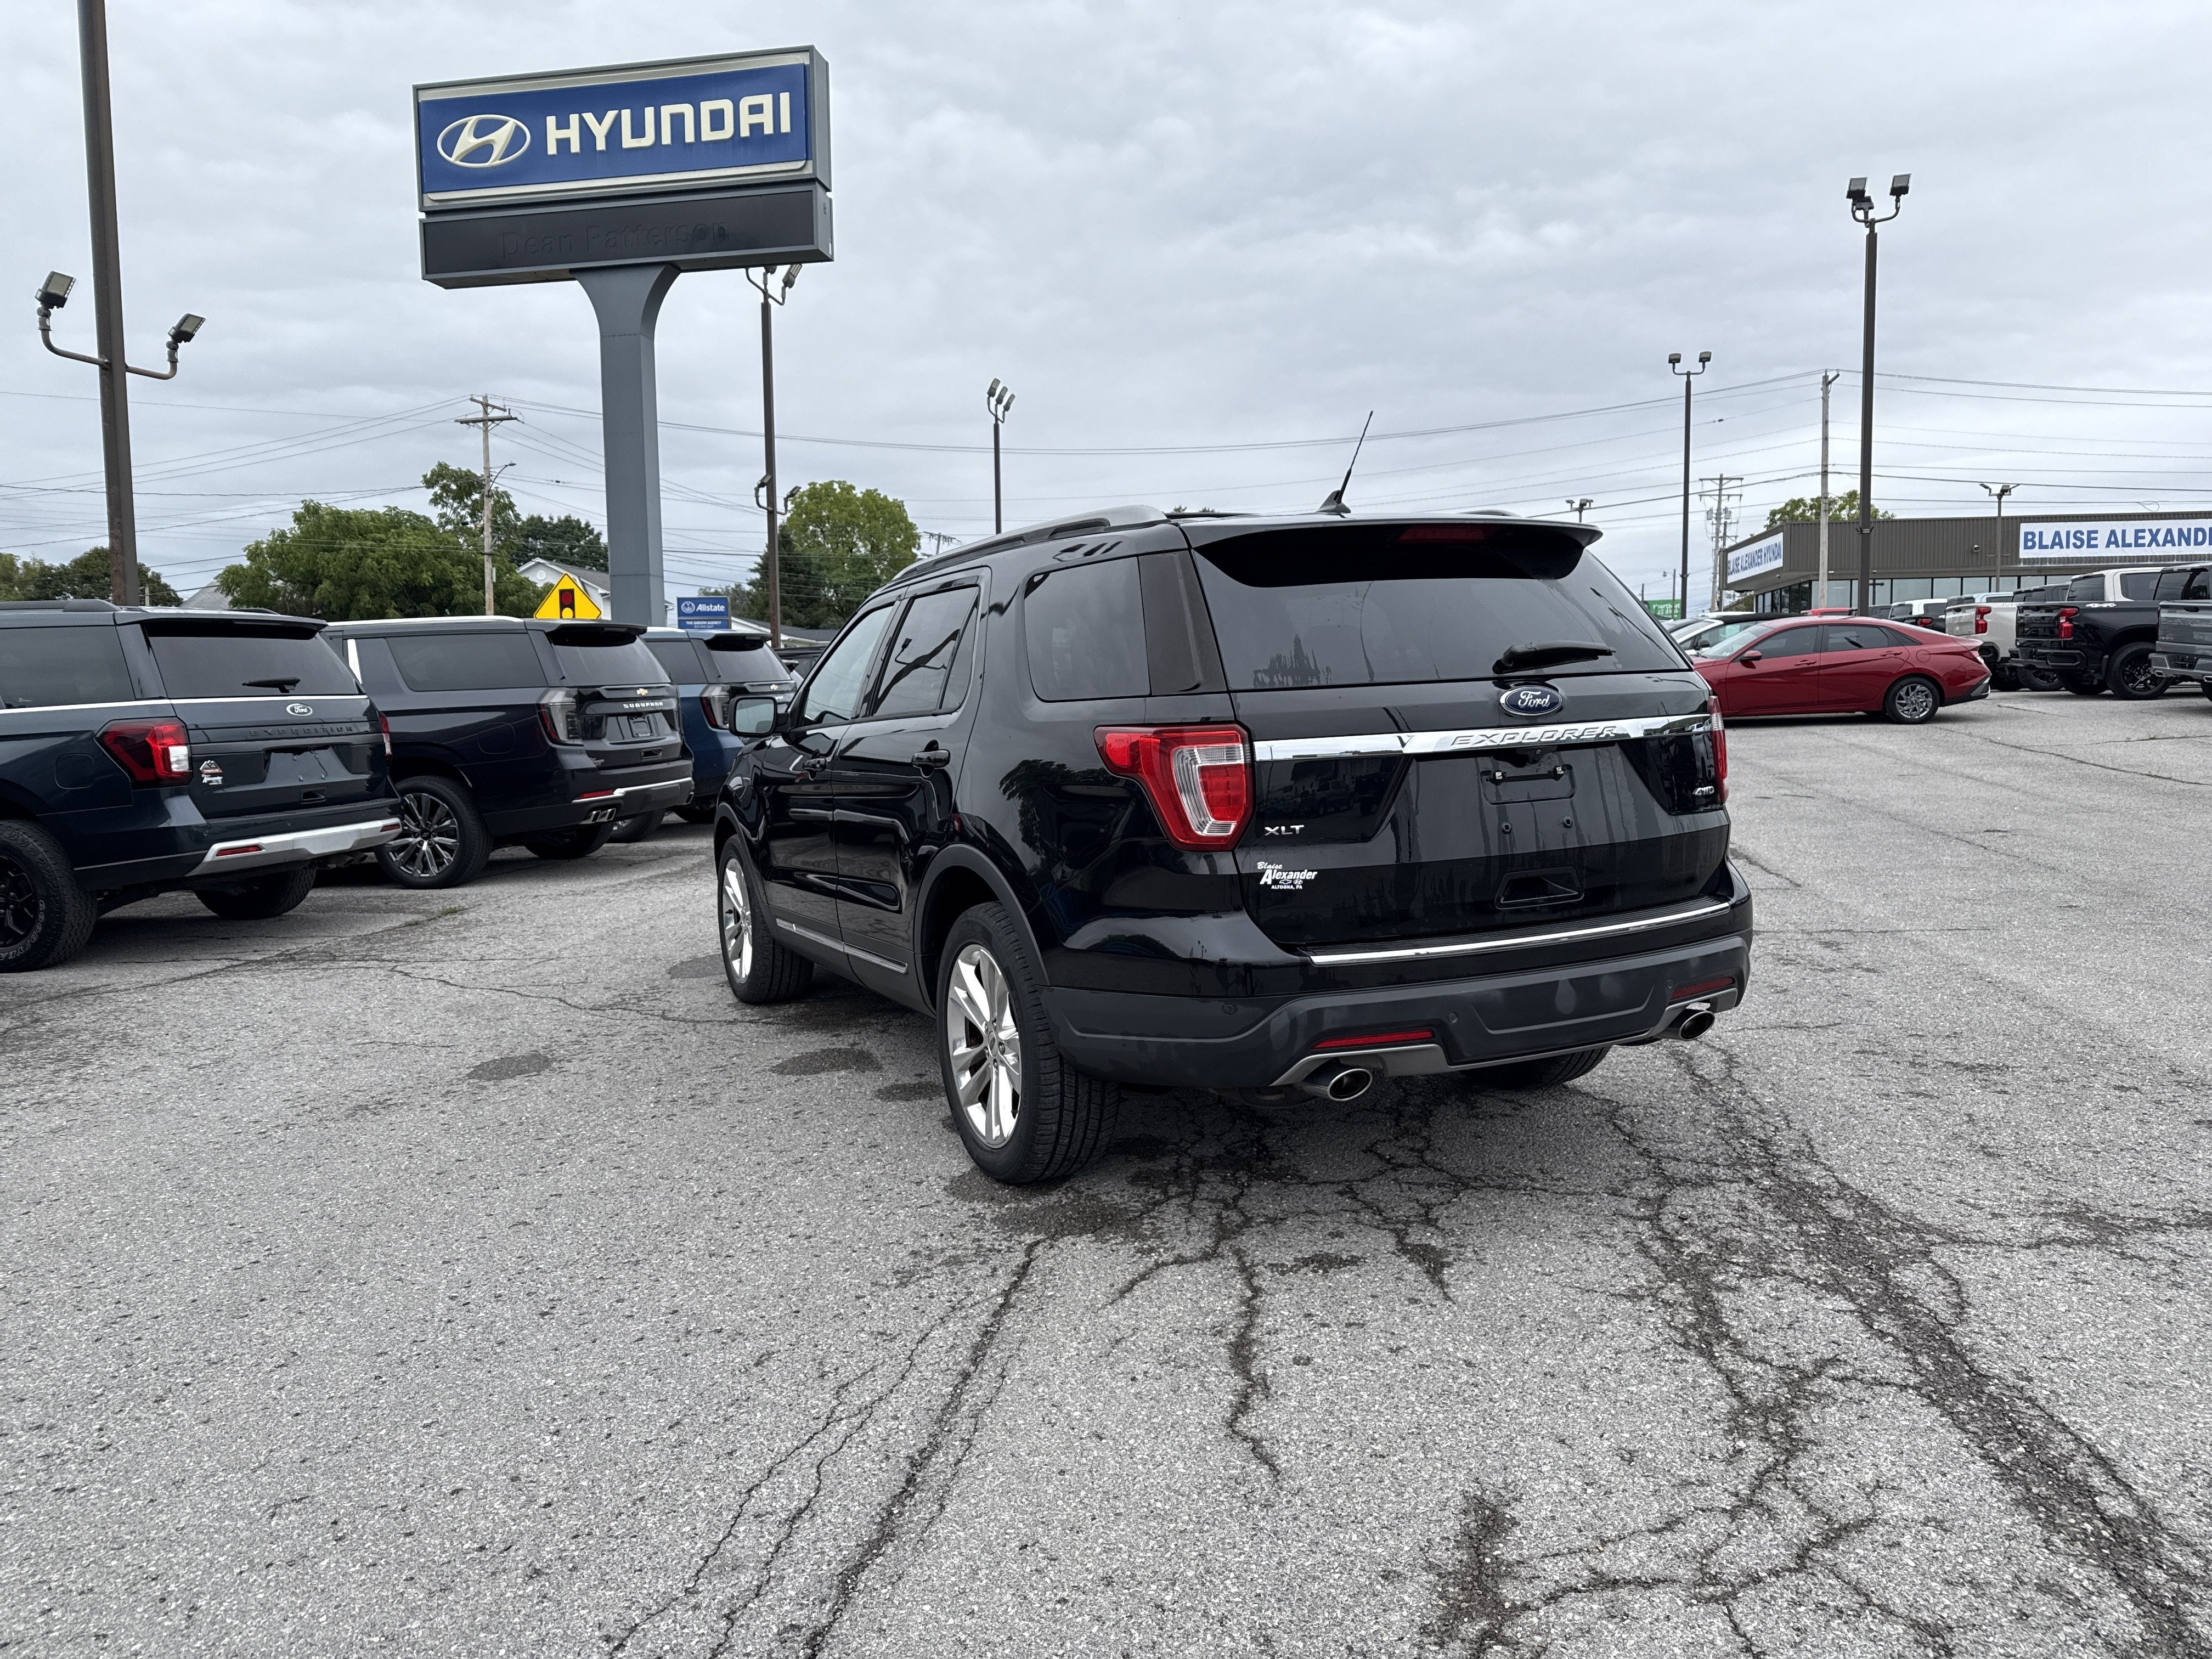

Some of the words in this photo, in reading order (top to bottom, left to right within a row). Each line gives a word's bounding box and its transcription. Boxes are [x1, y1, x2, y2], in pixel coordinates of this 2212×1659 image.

[546, 92, 791, 155] HYUNDAI
[502, 231, 573, 258] Dean
[586, 221, 730, 252] Patterson
[2023, 529, 2099, 550] BLAISE
[1728, 556, 1740, 576] BLAISE
[1740, 548, 1763, 573] ALEXANDER
[1763, 540, 1782, 565] HYUNDAI
[696, 603, 725, 612] Allstate
[1517, 691, 1551, 708] Ford
[249, 725, 353, 737] EXPEDITION
[1450, 725, 1618, 747] EXPLORER
[1265, 825, 1305, 836] XLT
[1257, 861, 1283, 870] Blaise
[1259, 869, 1318, 884] Alexander
